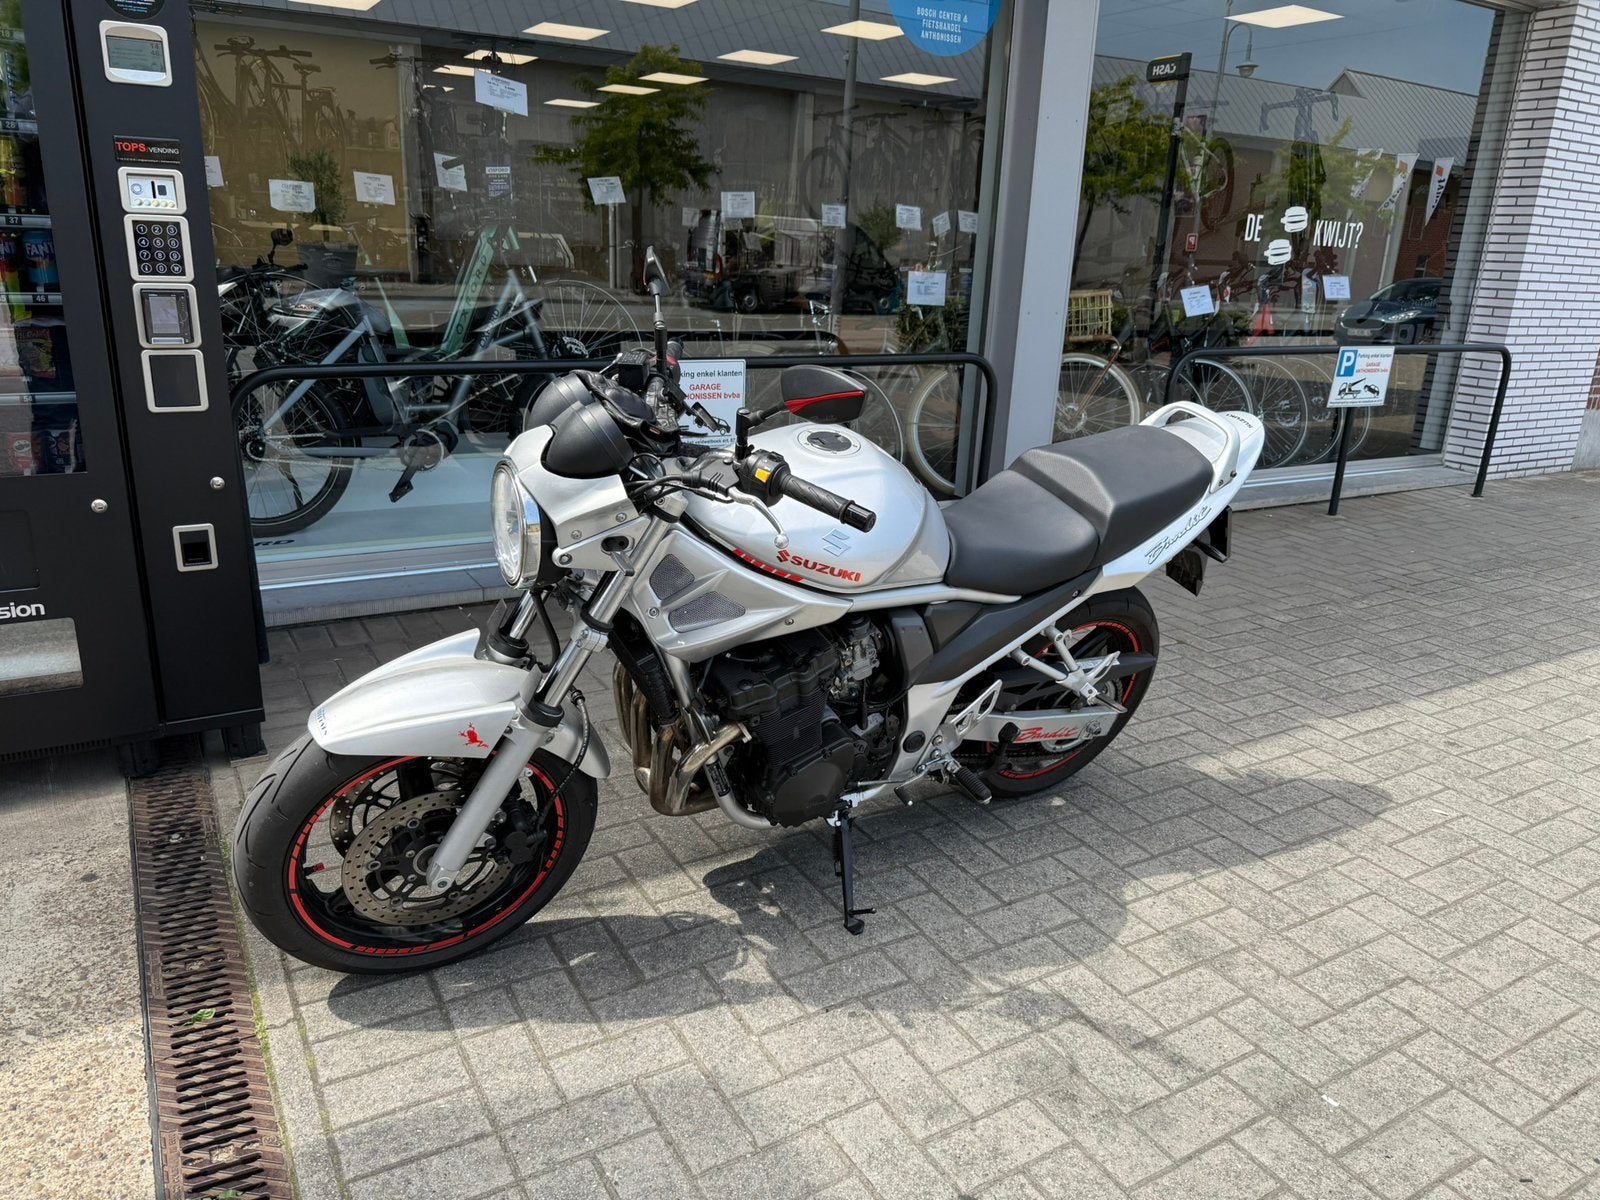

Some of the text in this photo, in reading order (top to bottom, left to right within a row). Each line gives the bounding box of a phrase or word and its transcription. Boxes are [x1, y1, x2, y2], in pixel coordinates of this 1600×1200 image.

[916, 6, 937, 17] BOSCH
[938, 10, 962, 22] CENTER
[922, 19, 962, 33] FIETSHANDEL
[920, 29, 962, 43] ANTHONISSEN
[115, 141, 180, 155] TOPS VENDING
[1244, 213, 1364, 249] DE KWIJT?
[25, 241, 55, 257] FANT
[456, 255, 487, 335] OXFORD
[1340, 351, 1355, 376] P
[680, 370, 695, 379] king
[696, 370, 716, 378] enkel
[689, 383, 722, 391] GARAGE
[688, 392, 722, 400] ONISSEN
[790, 555, 862, 583] SUZUKI
[0, 601, 46, 619] sion
